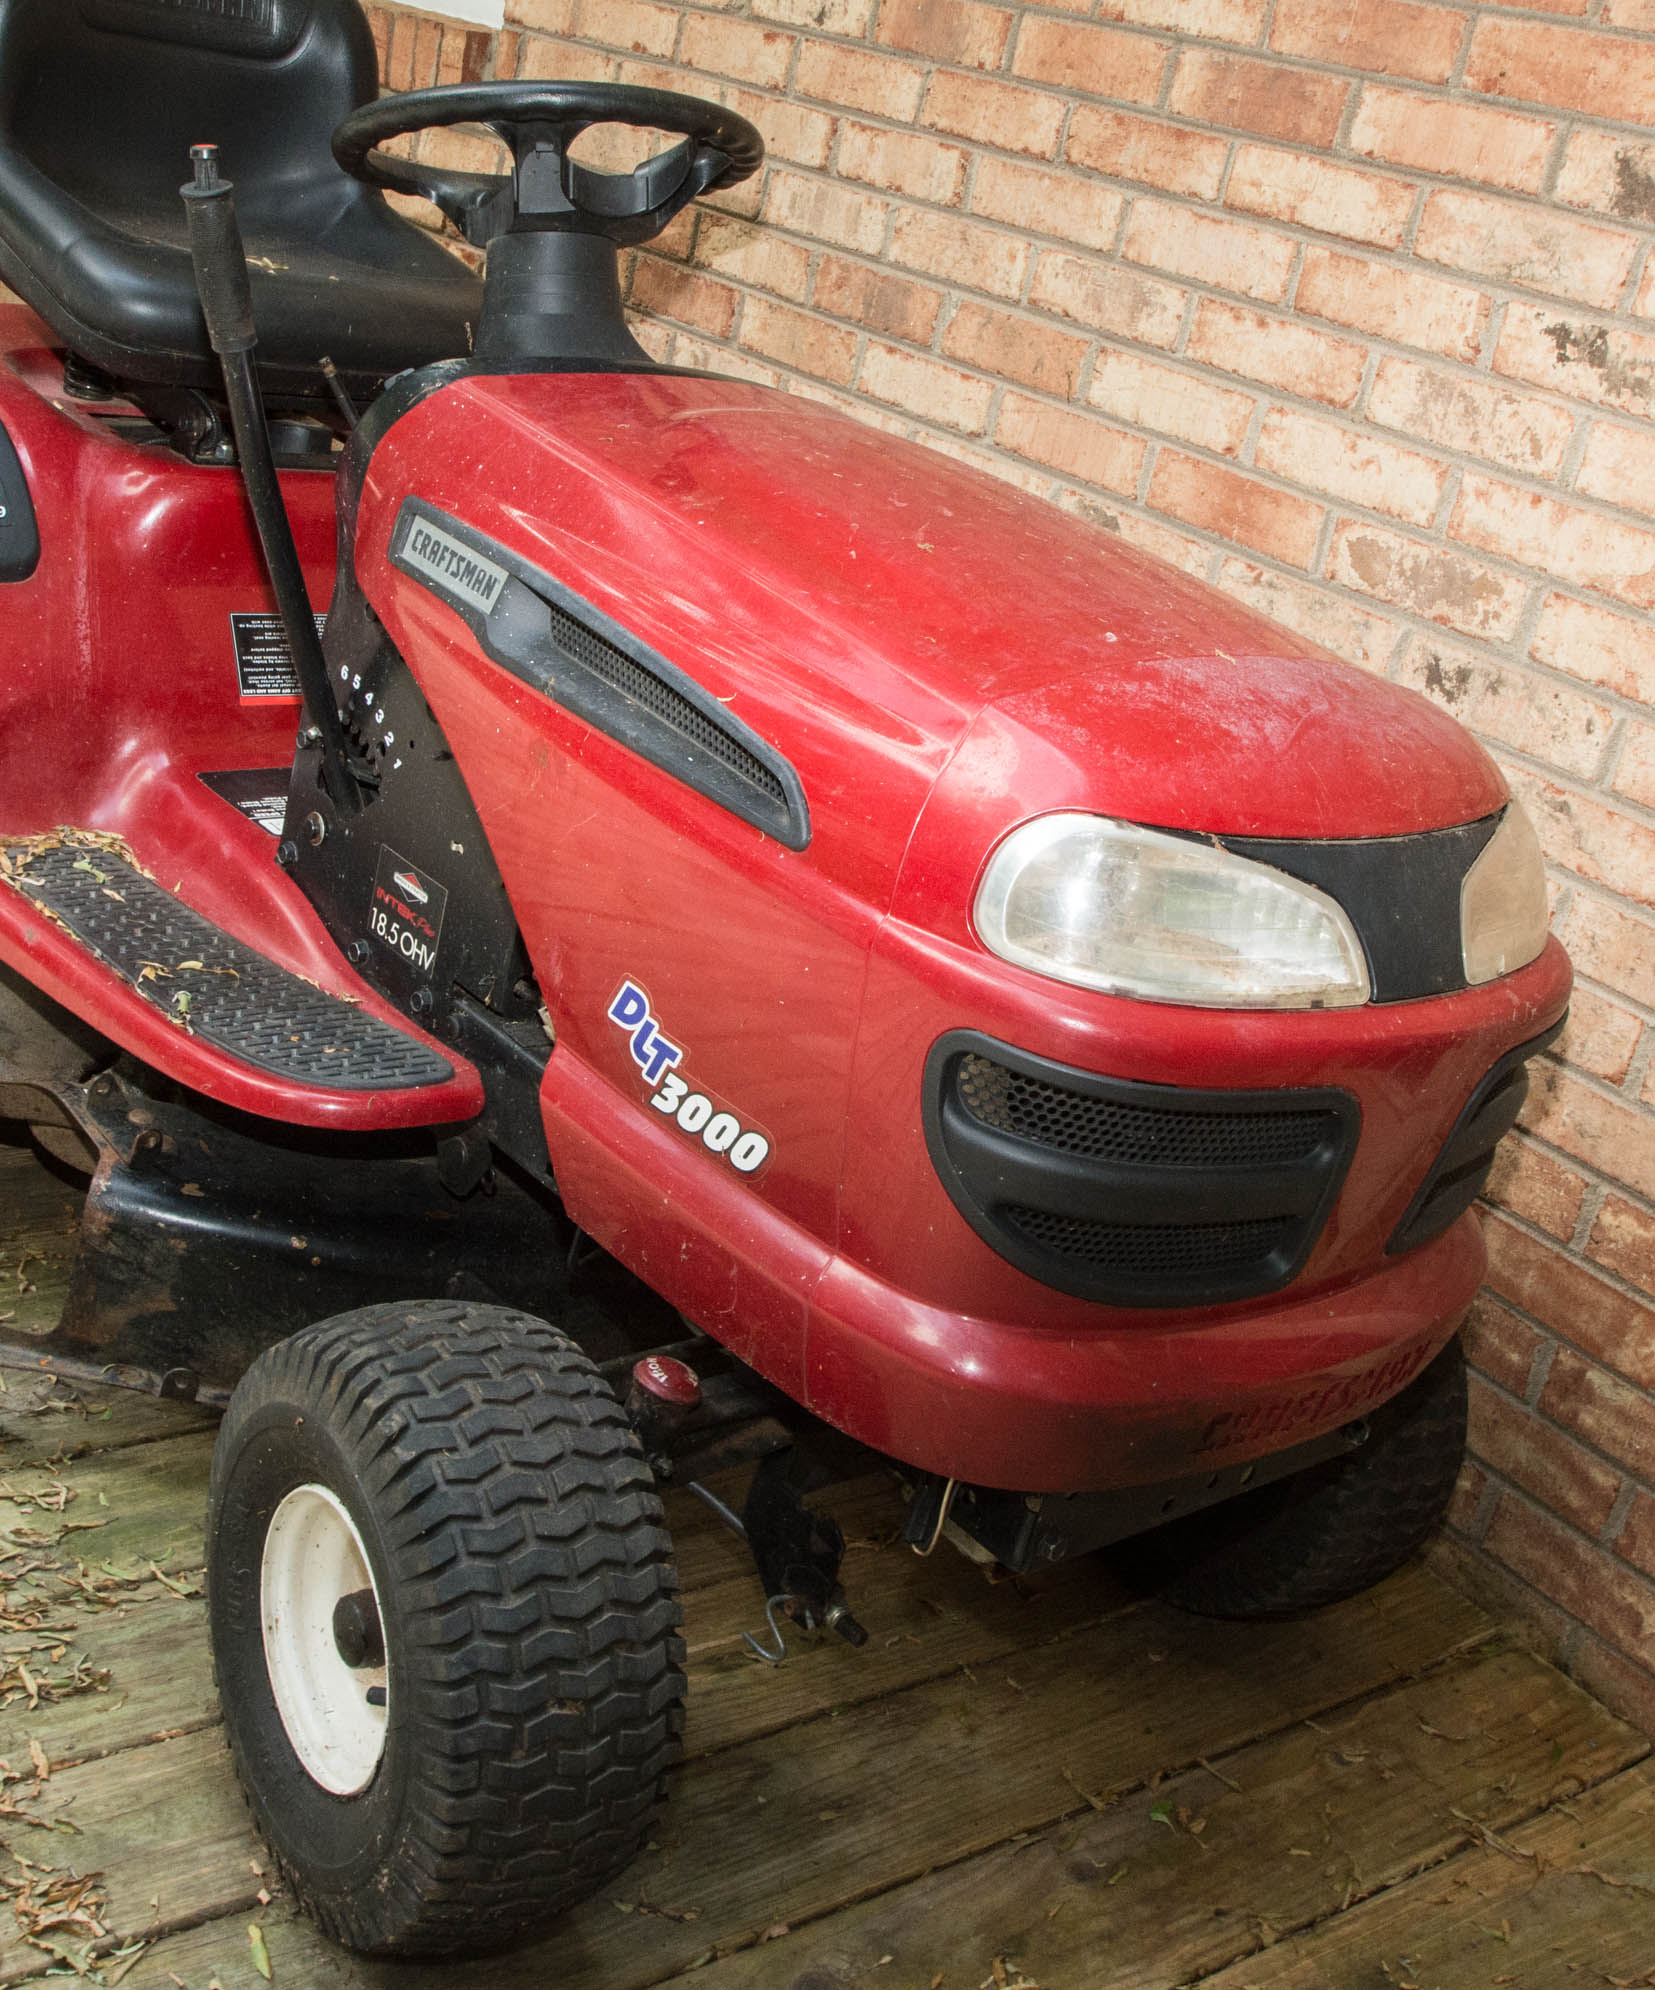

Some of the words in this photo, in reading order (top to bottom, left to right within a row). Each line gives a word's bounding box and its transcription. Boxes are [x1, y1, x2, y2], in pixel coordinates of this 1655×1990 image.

[411, 528, 498, 601] CRAFTSMAN
[341, 664, 349, 681] 6
[353, 673, 361, 690] 5
[365, 692, 374, 706] 4
[375, 708, 385, 724] 3
[384, 731, 394, 747] 2
[393, 758, 402, 769] 1
[371, 906, 400, 945] 18.5
[400, 931, 435, 971] OHV
[376, 885, 417, 927] INTEK
[608, 981, 683, 1086] DLT
[650, 1072, 770, 1173] 3000
